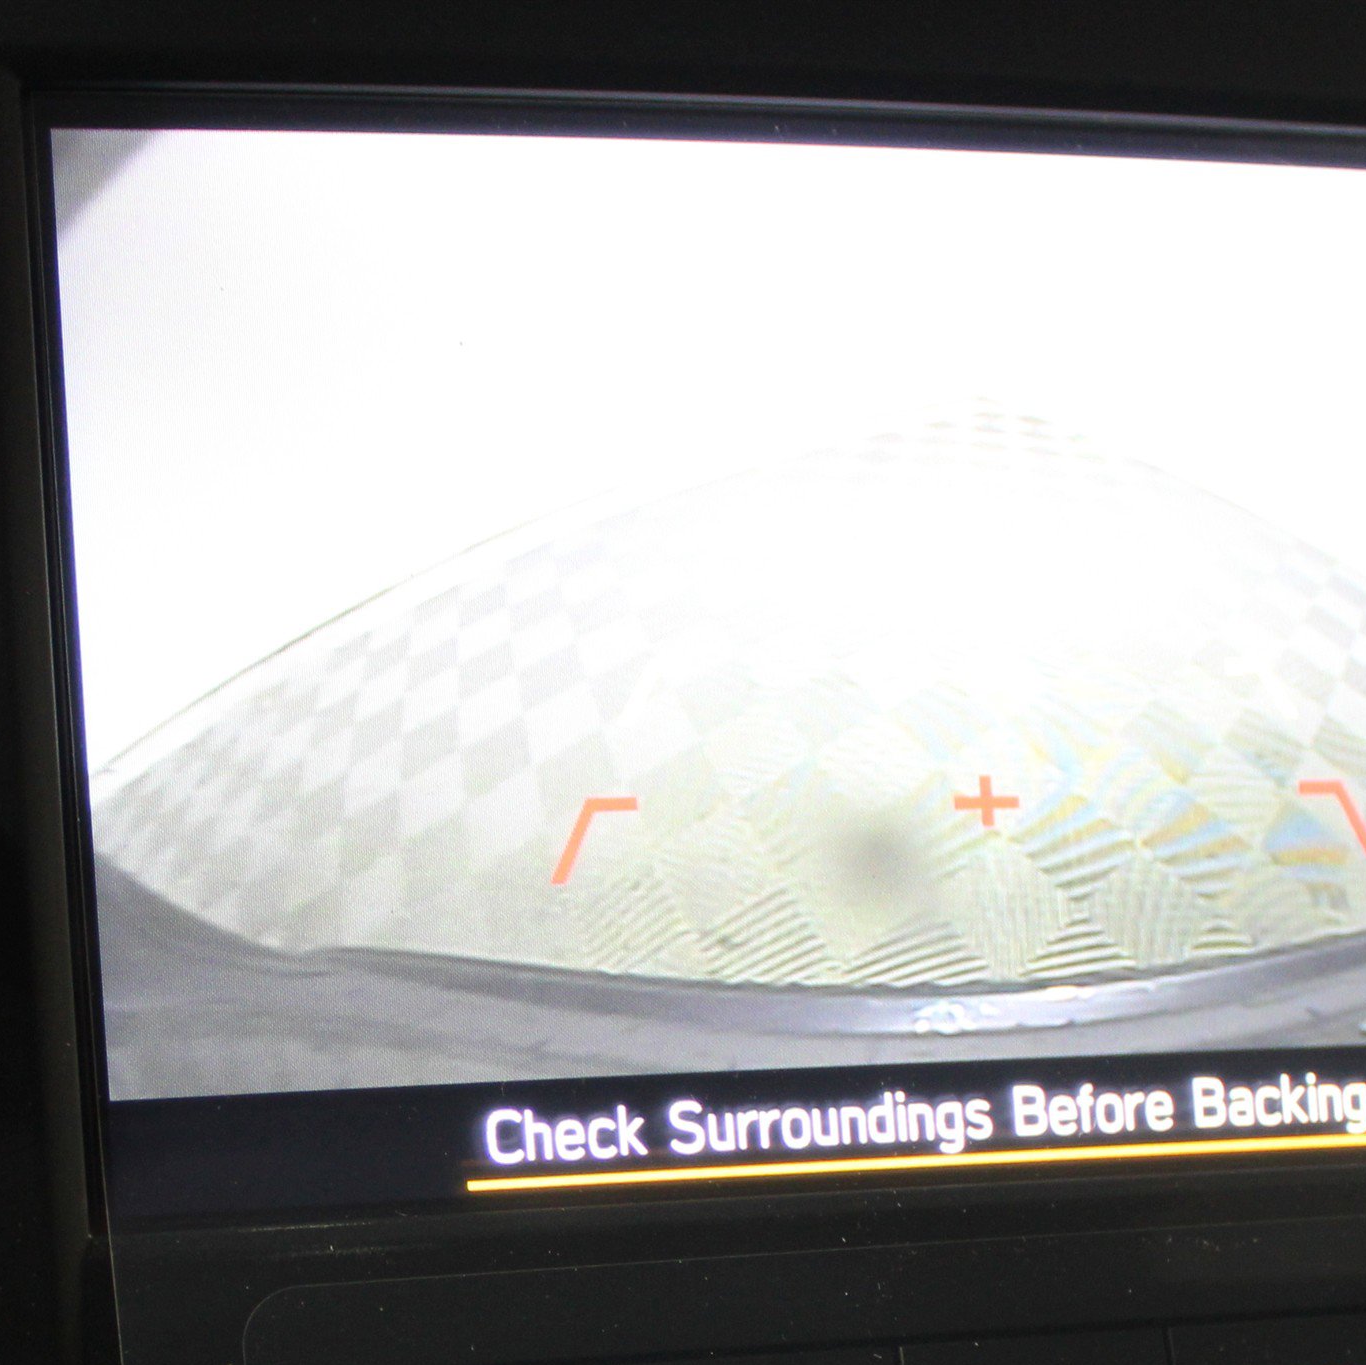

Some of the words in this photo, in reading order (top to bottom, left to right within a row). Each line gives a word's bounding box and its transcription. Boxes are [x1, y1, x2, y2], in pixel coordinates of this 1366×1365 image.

[485, 1104, 649, 1165] Check
[668, 1090, 994, 1155] Surroundings
[1011, 1082, 1175, 1137] Before
